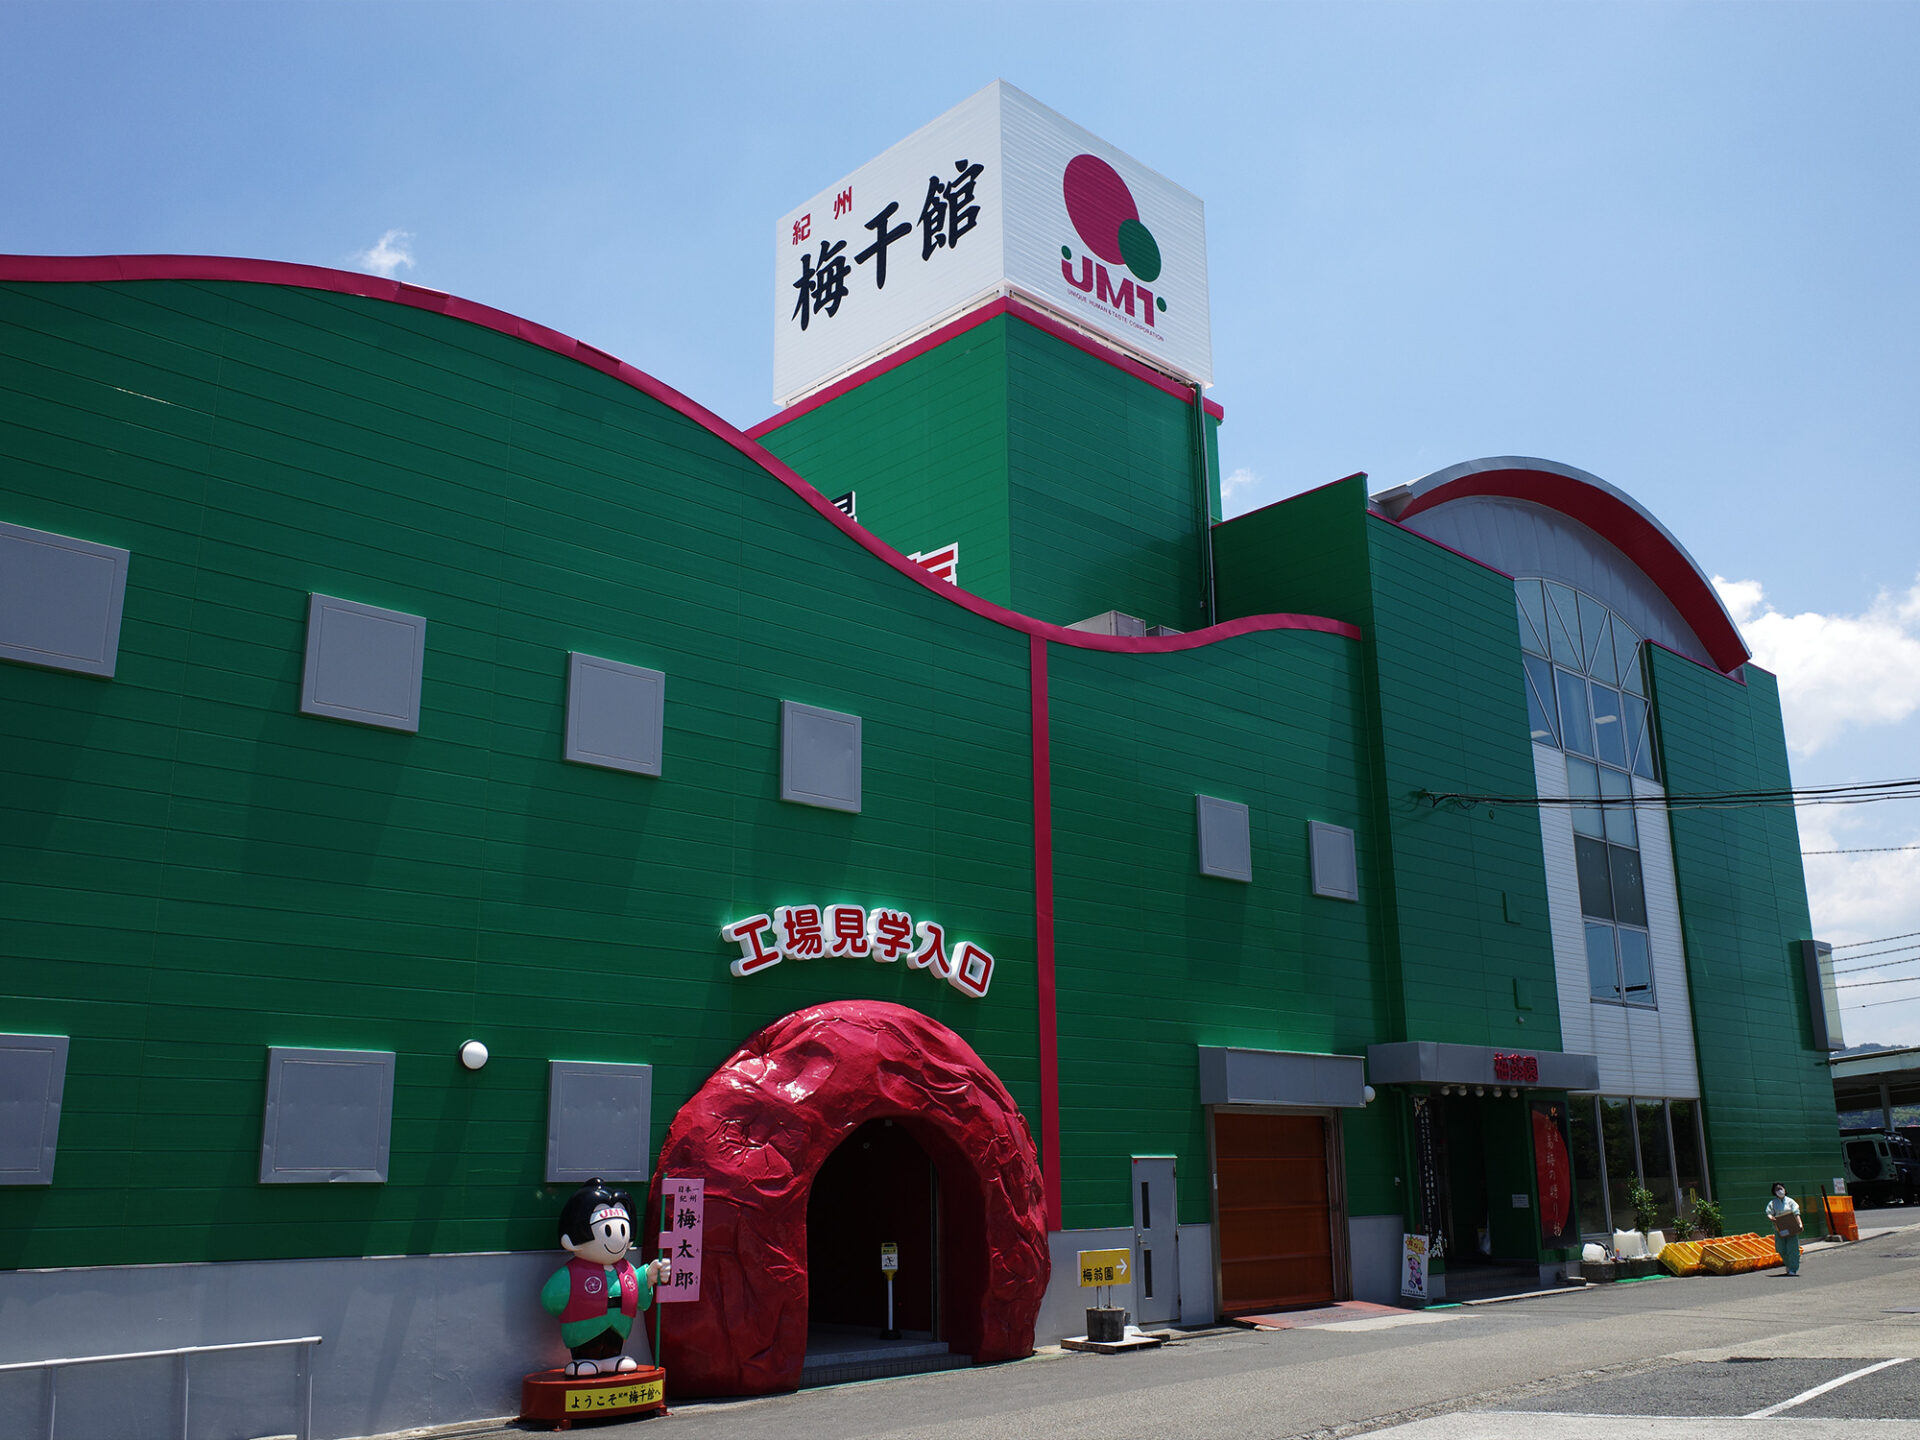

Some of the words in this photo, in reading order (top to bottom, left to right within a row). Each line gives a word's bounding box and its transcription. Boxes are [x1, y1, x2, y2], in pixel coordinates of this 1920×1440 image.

[791, 158, 985, 331] 梅干館
[792, 185, 853, 246] 紀州
[1067, 288, 1087, 303] UNIQUE
[1089, 300, 1108, 313] HUMAN
[1129, 320, 1165, 342] CORPORATION
[729, 905, 994, 996] 工場見学入口
[678, 1185, 700, 1193] 日本一
[679, 1194, 698, 1203] 紀州
[674, 1207, 697, 1291] 梅太郎
